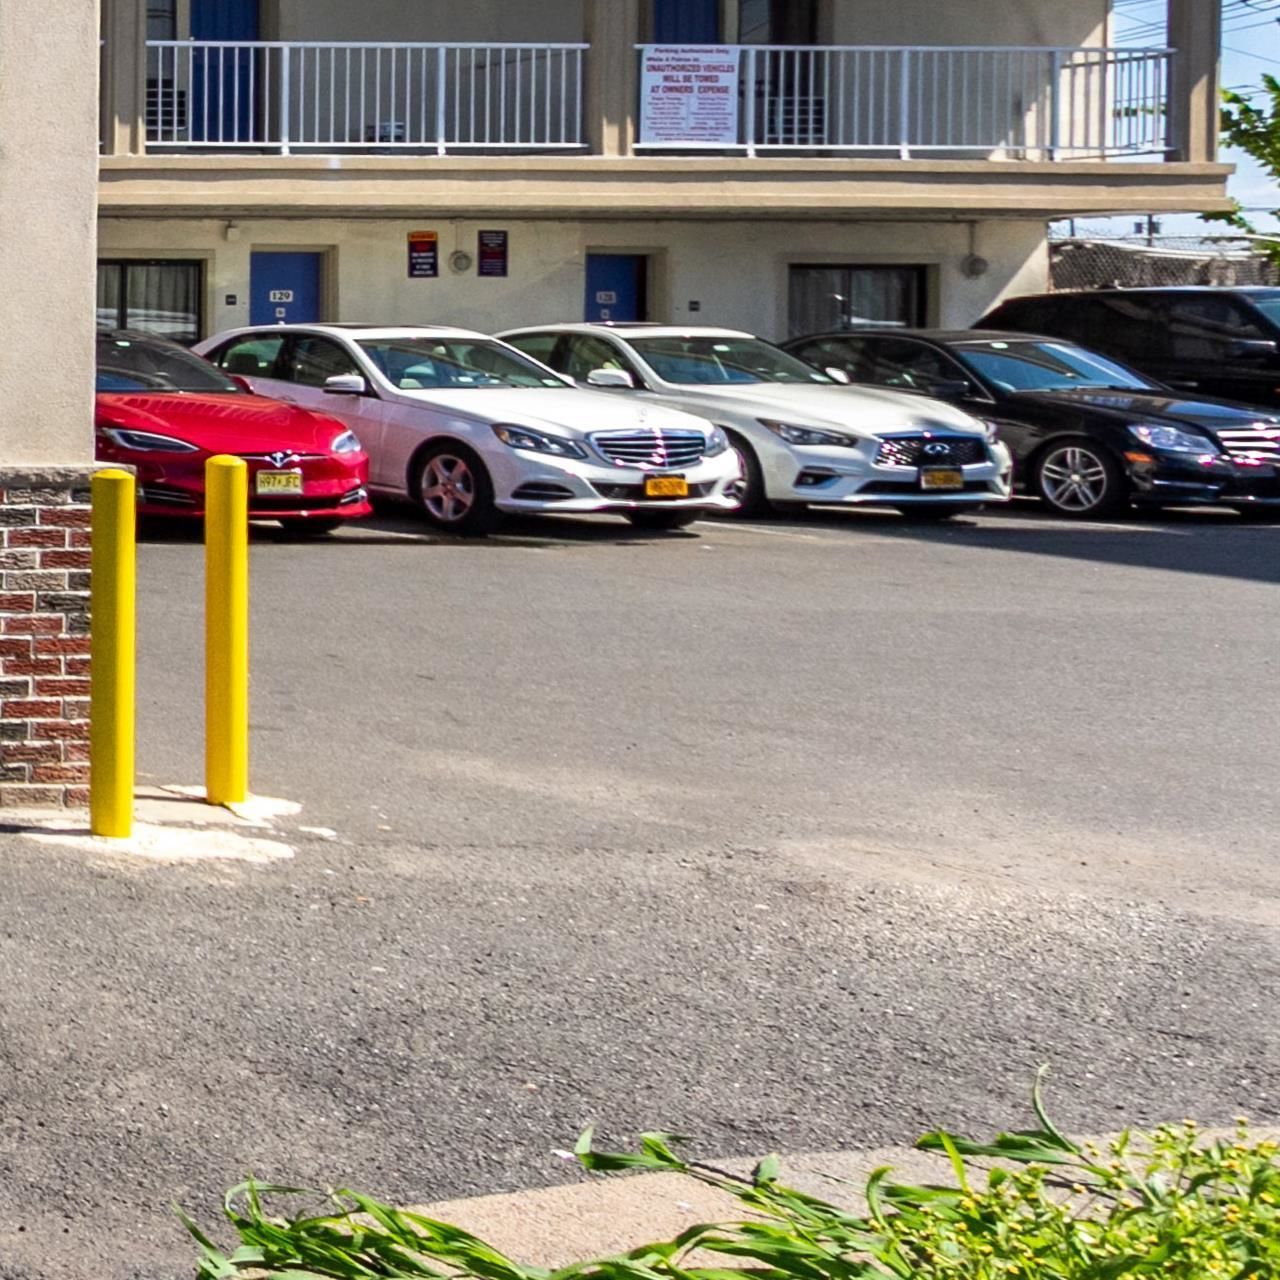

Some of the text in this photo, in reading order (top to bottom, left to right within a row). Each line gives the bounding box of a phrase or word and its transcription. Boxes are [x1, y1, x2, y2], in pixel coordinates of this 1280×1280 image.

[647, 64, 735, 73] UNAUTHORIZED VEHICLES
[662, 75, 719, 83] WILL BE TOWED
[661, 86, 694, 94] OWNERS
[697, 86, 729, 94] EXPENSE
[272, 292, 290, 300] 129
